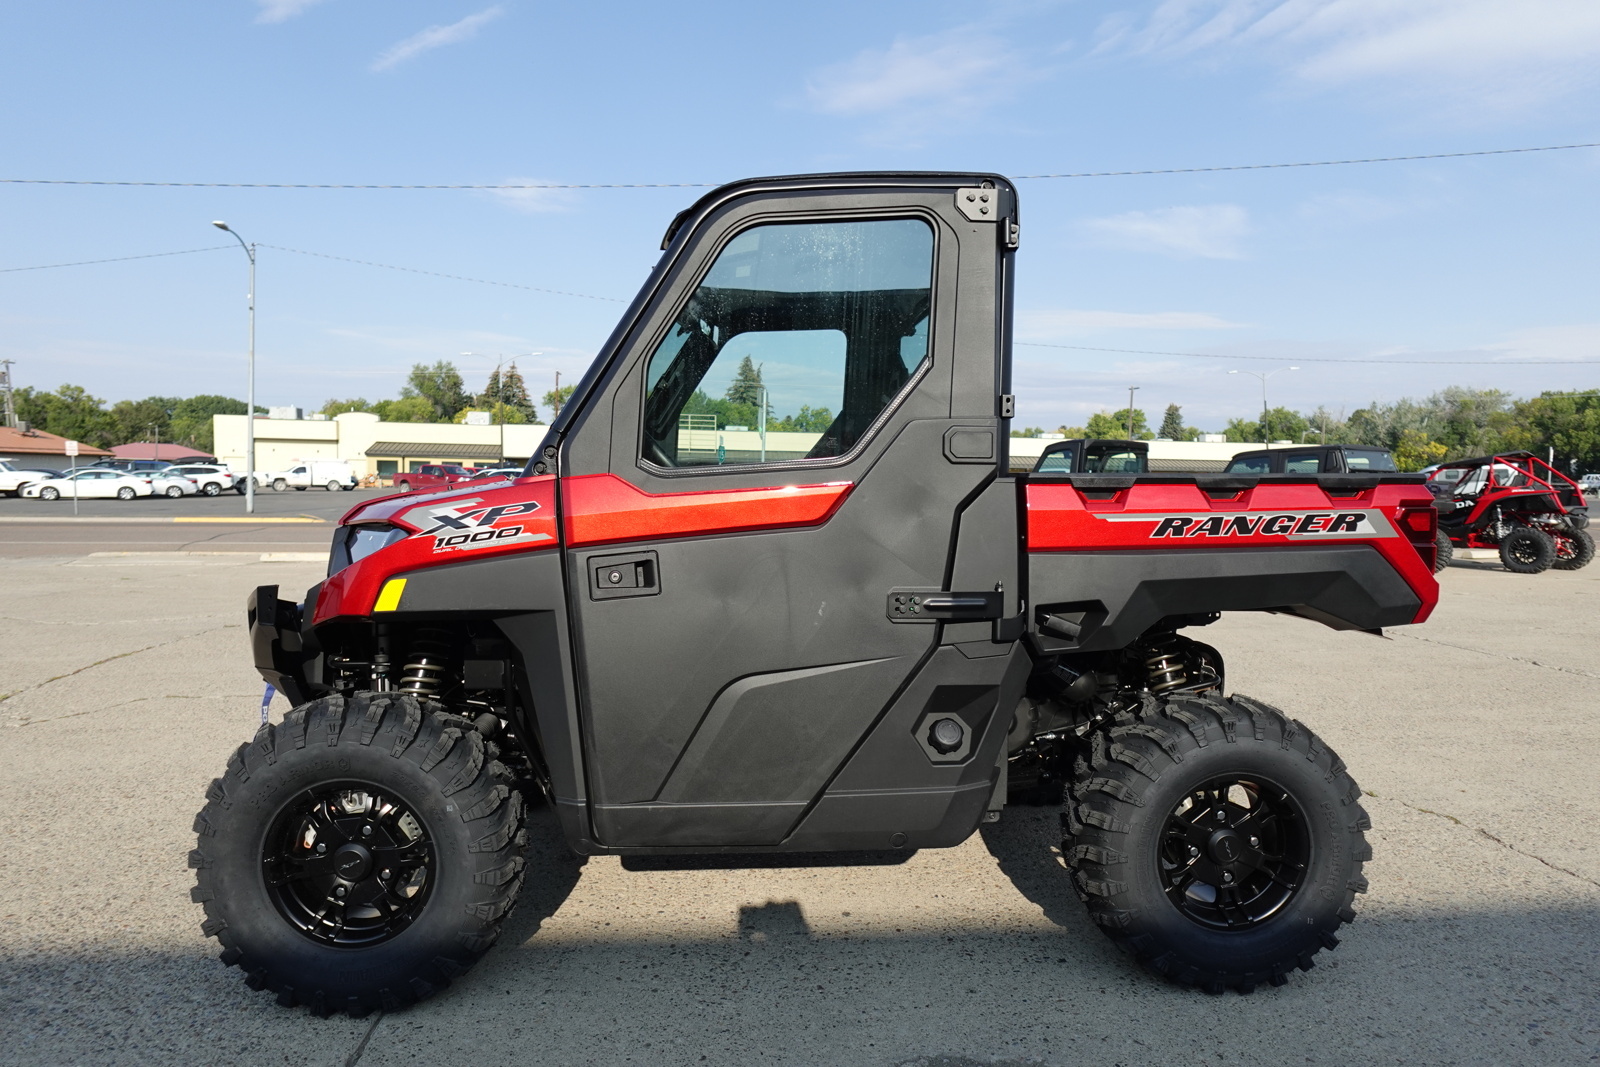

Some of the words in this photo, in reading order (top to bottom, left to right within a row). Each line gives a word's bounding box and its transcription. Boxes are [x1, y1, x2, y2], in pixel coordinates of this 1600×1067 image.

[411, 501, 541, 538] XP
[1150, 512, 1368, 538] RANGER
[433, 525, 524, 549] 1000
[433, 545, 454, 554] DUAL
